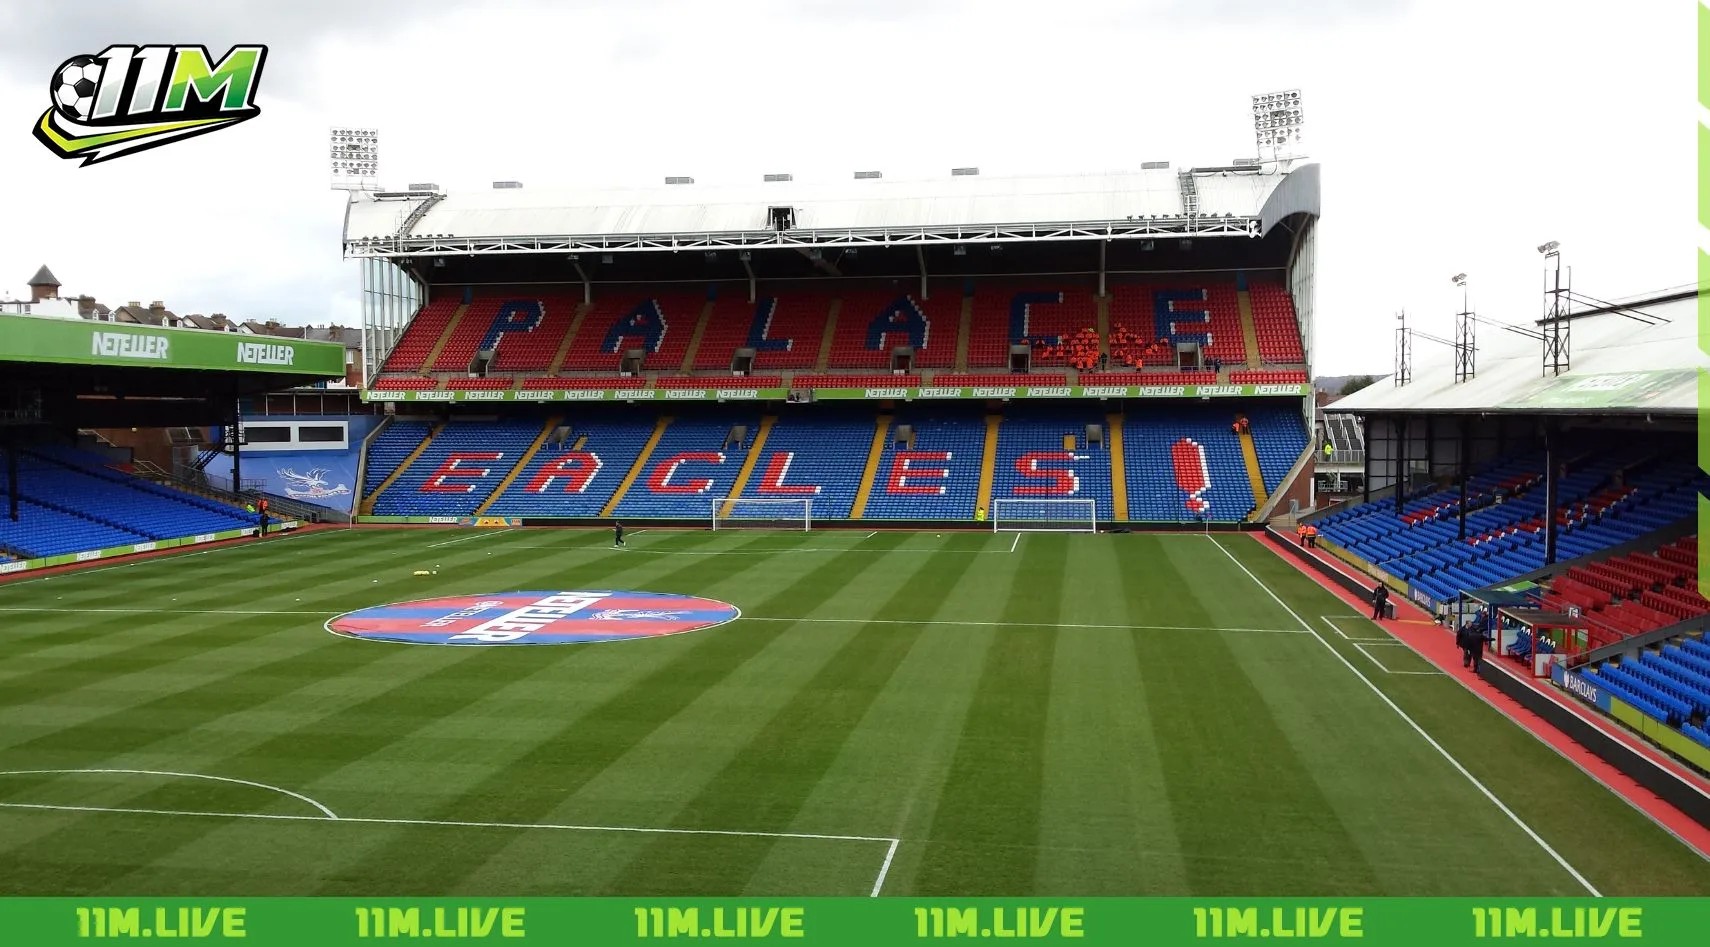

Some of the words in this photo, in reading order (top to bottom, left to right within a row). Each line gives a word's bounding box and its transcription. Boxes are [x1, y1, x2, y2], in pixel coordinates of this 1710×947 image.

[479, 289, 1212, 353] PALACE
[92, 331, 169, 359] NETELLER
[236, 342, 295, 365] NETELLER
[564, 390, 604, 399] NETELLER
[614, 390, 655, 399] NETELLER
[665, 390, 706, 398] NETELLER
[716, 389, 757, 398] NETELLER
[865, 389, 907, 398] NETELLER
[919, 388, 961, 397] NETELLER
[973, 388, 1016, 397] NETELLER
[1027, 387, 1071, 396] NETELLER
[1083, 387, 1127, 396] NETELLER
[1139, 386, 1184, 396] NETELLER
[1196, 386, 1242, 395] NETELLER
[1254, 385, 1301, 395] NETELLER
[367, 391, 406, 400] NETELLER
[415, 391, 455, 400] NETELLER
[465, 391, 504, 400] NETELLER
[514, 391, 554, 400] NETELLER
[449, 591, 613, 641] NETELLER
[1569, 675, 1597, 702] BARCLAYS
